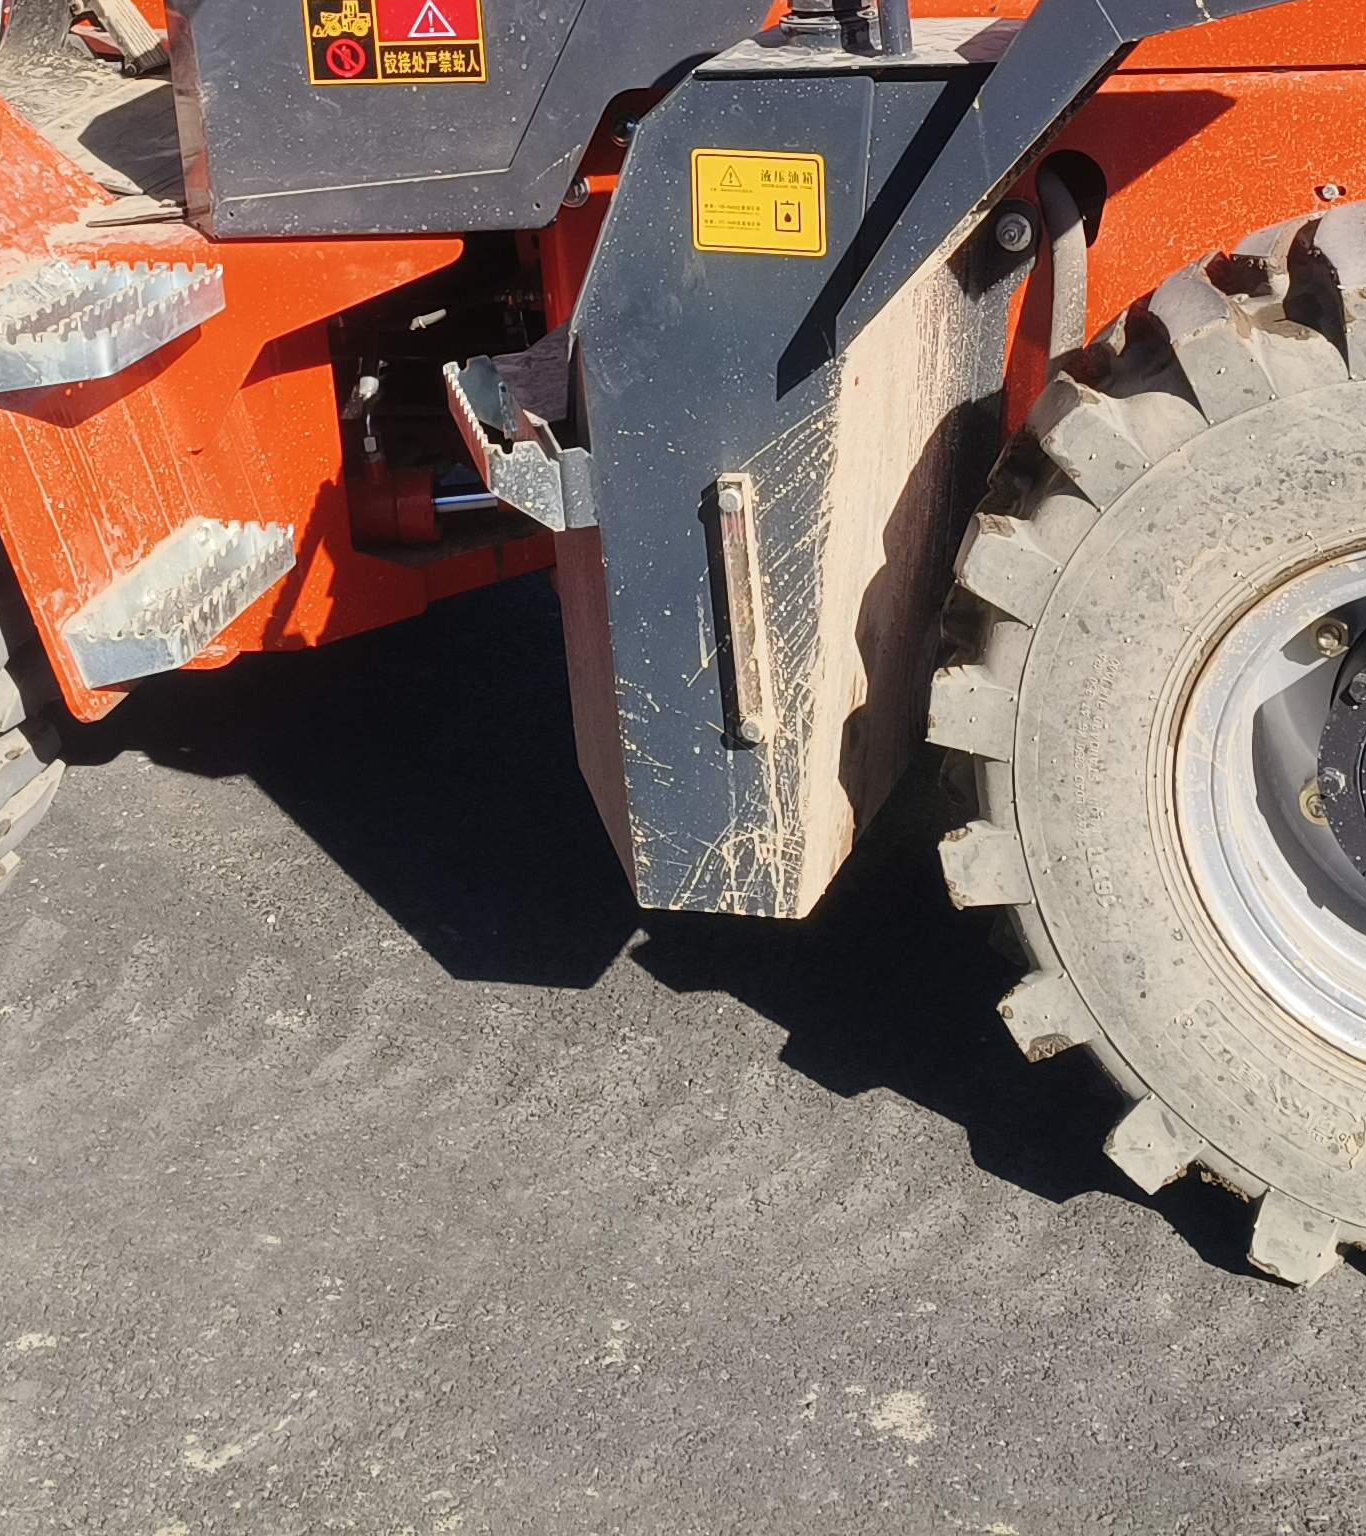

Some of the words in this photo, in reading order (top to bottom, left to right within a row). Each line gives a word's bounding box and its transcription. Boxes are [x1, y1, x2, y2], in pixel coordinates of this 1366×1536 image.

[384, 49, 480, 74] 铰接处严禁站人
[761, 170, 812, 184] 液压油箱
